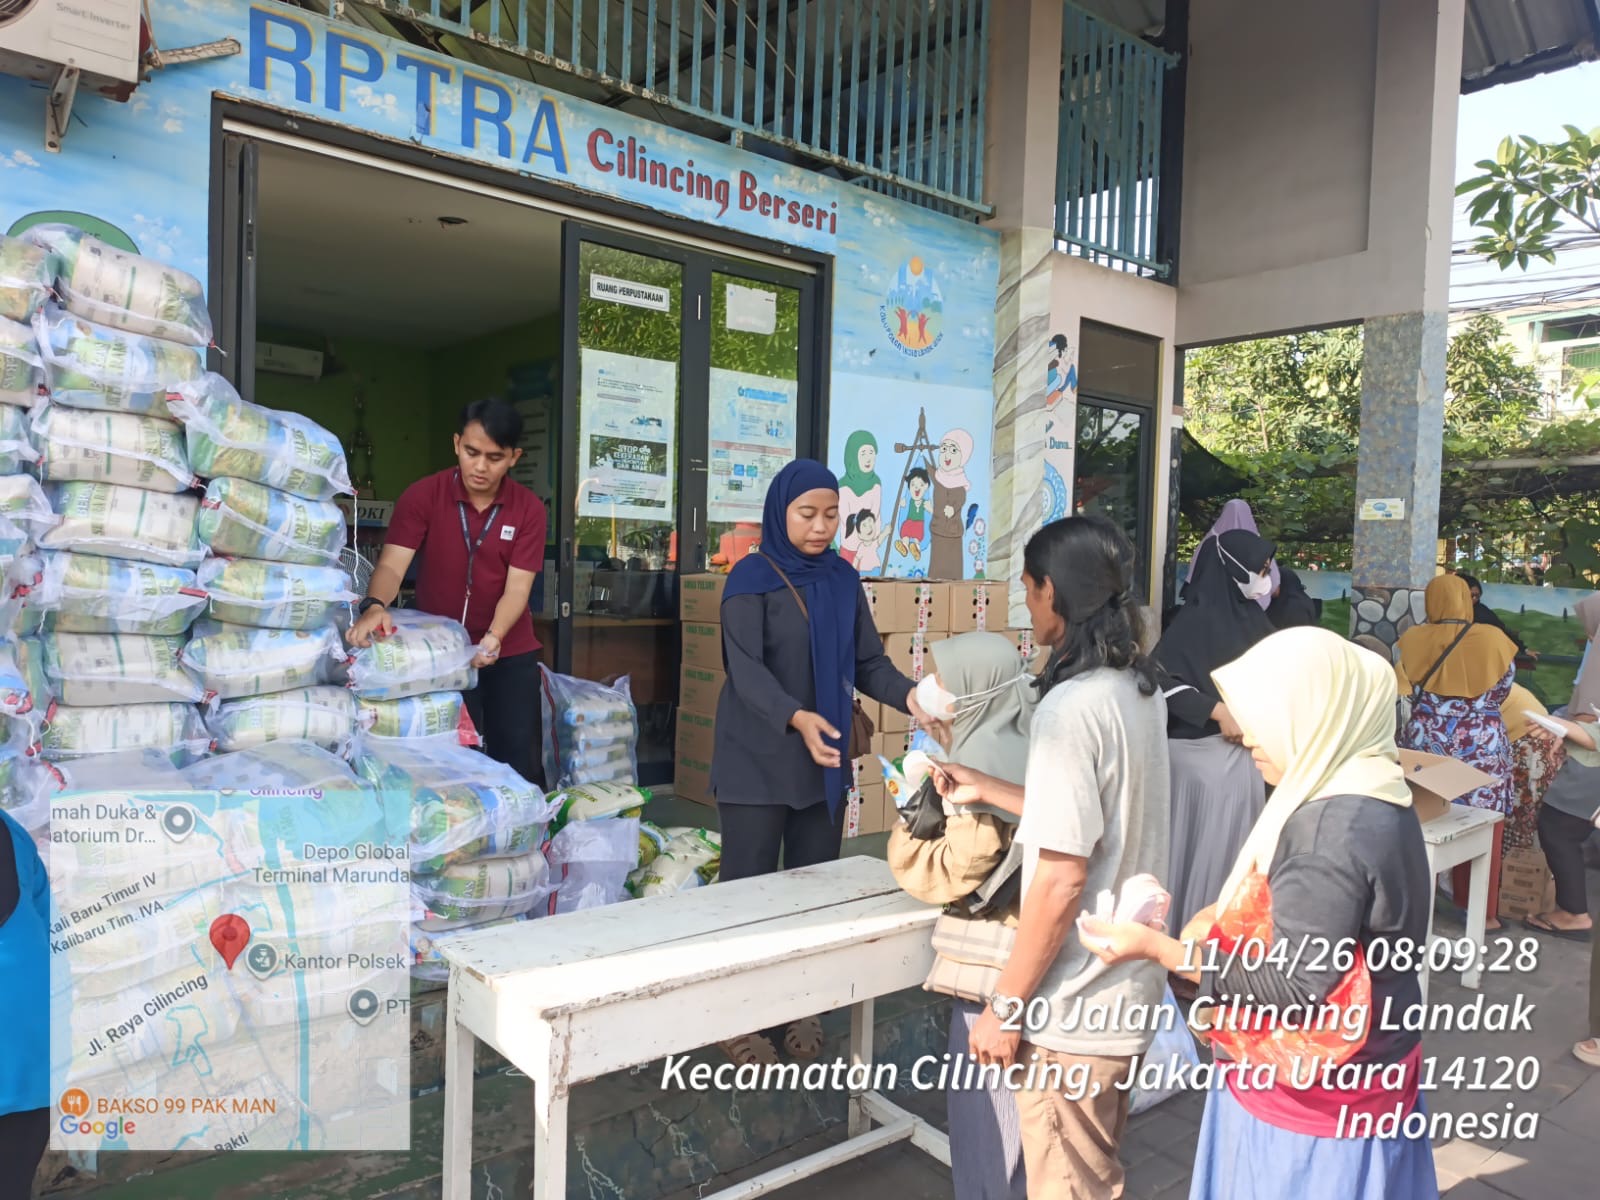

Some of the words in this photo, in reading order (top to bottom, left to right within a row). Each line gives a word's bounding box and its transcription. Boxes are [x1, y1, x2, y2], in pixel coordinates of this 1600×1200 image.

[56, 2, 88, 18] Smart
[89, 12, 131, 31] Inverter
[250, 6, 571, 175] RPTRA
[587, 128, 730, 219] Cilincing
[738, 170, 837, 235] Berseri
[597, 282, 618, 295] RUANG
[619, 286, 664, 303] PERPUSTAKAAN
